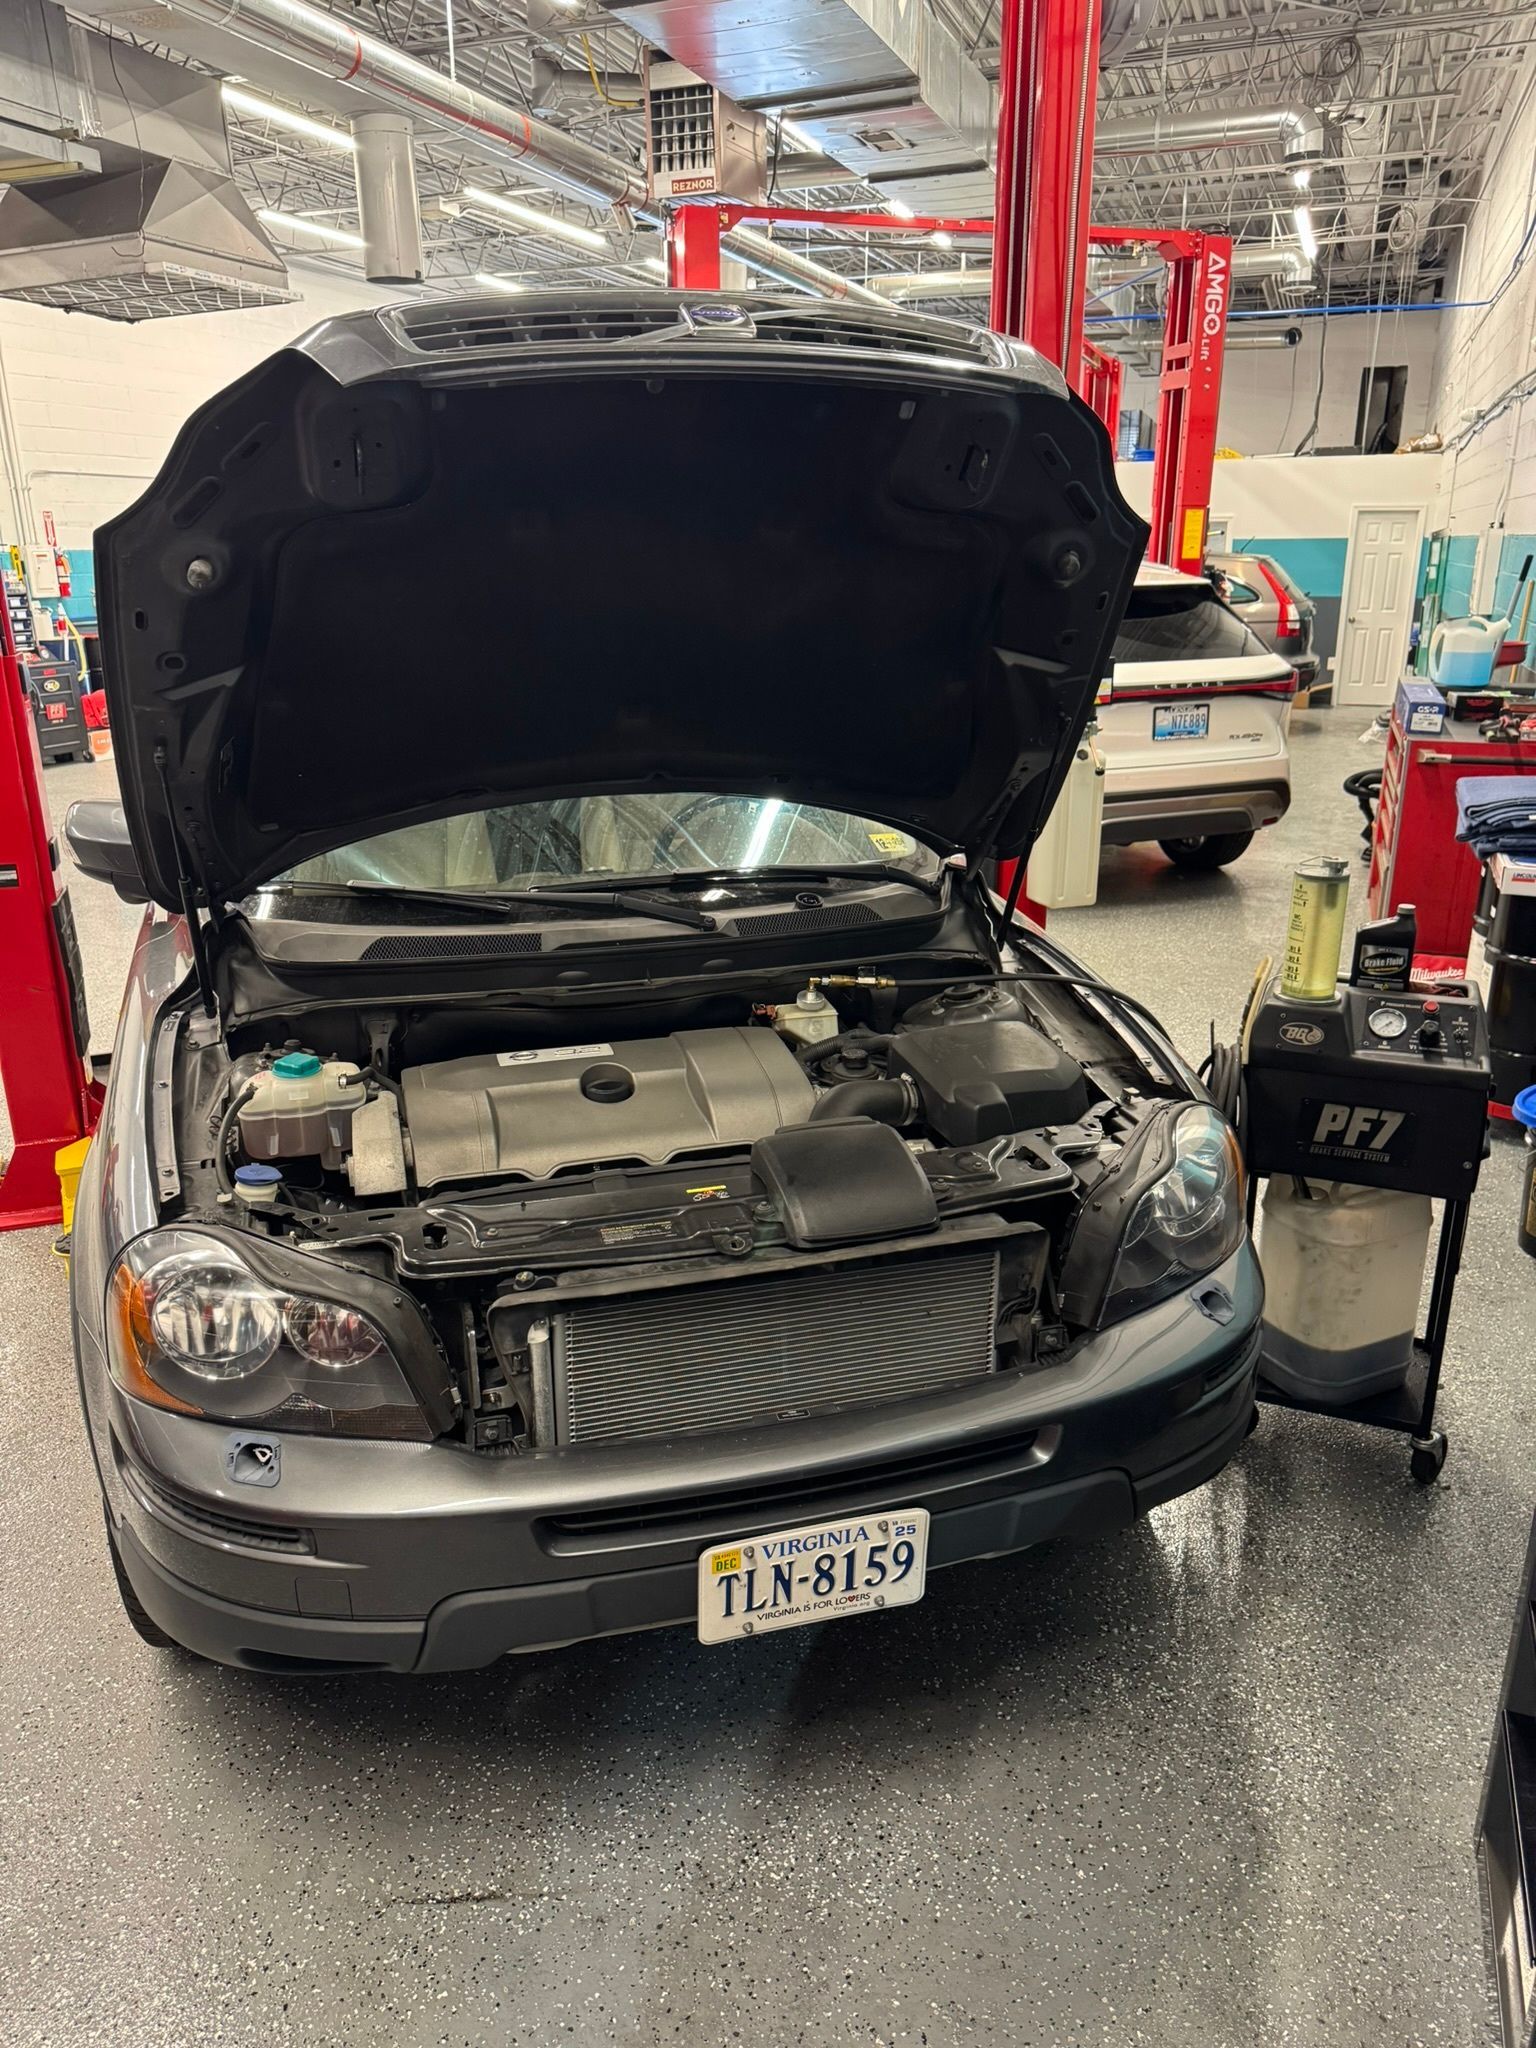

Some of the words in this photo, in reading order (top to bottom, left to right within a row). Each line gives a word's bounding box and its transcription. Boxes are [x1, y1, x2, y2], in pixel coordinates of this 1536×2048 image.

[672, 179, 713, 192] REZNOR
[1203, 251, 1227, 336] AMGO
[1154, 681, 1224, 690] LEXUS
[1171, 713, 1206, 730] N7E889
[1364, 958, 1385, 968] Brake
[1385, 957, 1404, 966] Fluid
[1409, 967, 1464, 982] Milwaukee
[1286, 1026, 1309, 1041] BG
[1312, 1103, 1406, 1150] PF7
[1310, 1146, 1331, 1155] BRAKE
[1334, 1149, 1361, 1159] SERVICE
[1363, 1152, 1390, 1162] SYSTEM
[895, 1524, 916, 1537] 25
[762, 1526, 869, 1560] VIRGINIA
[716, 1558, 737, 1571] DEC
[717, 1540, 915, 1617] TLN-8159
[757, 1606, 800, 1621] VIRGINIA
[803, 1603, 811, 1612] IS
[813, 1600, 833, 1610] FOR
